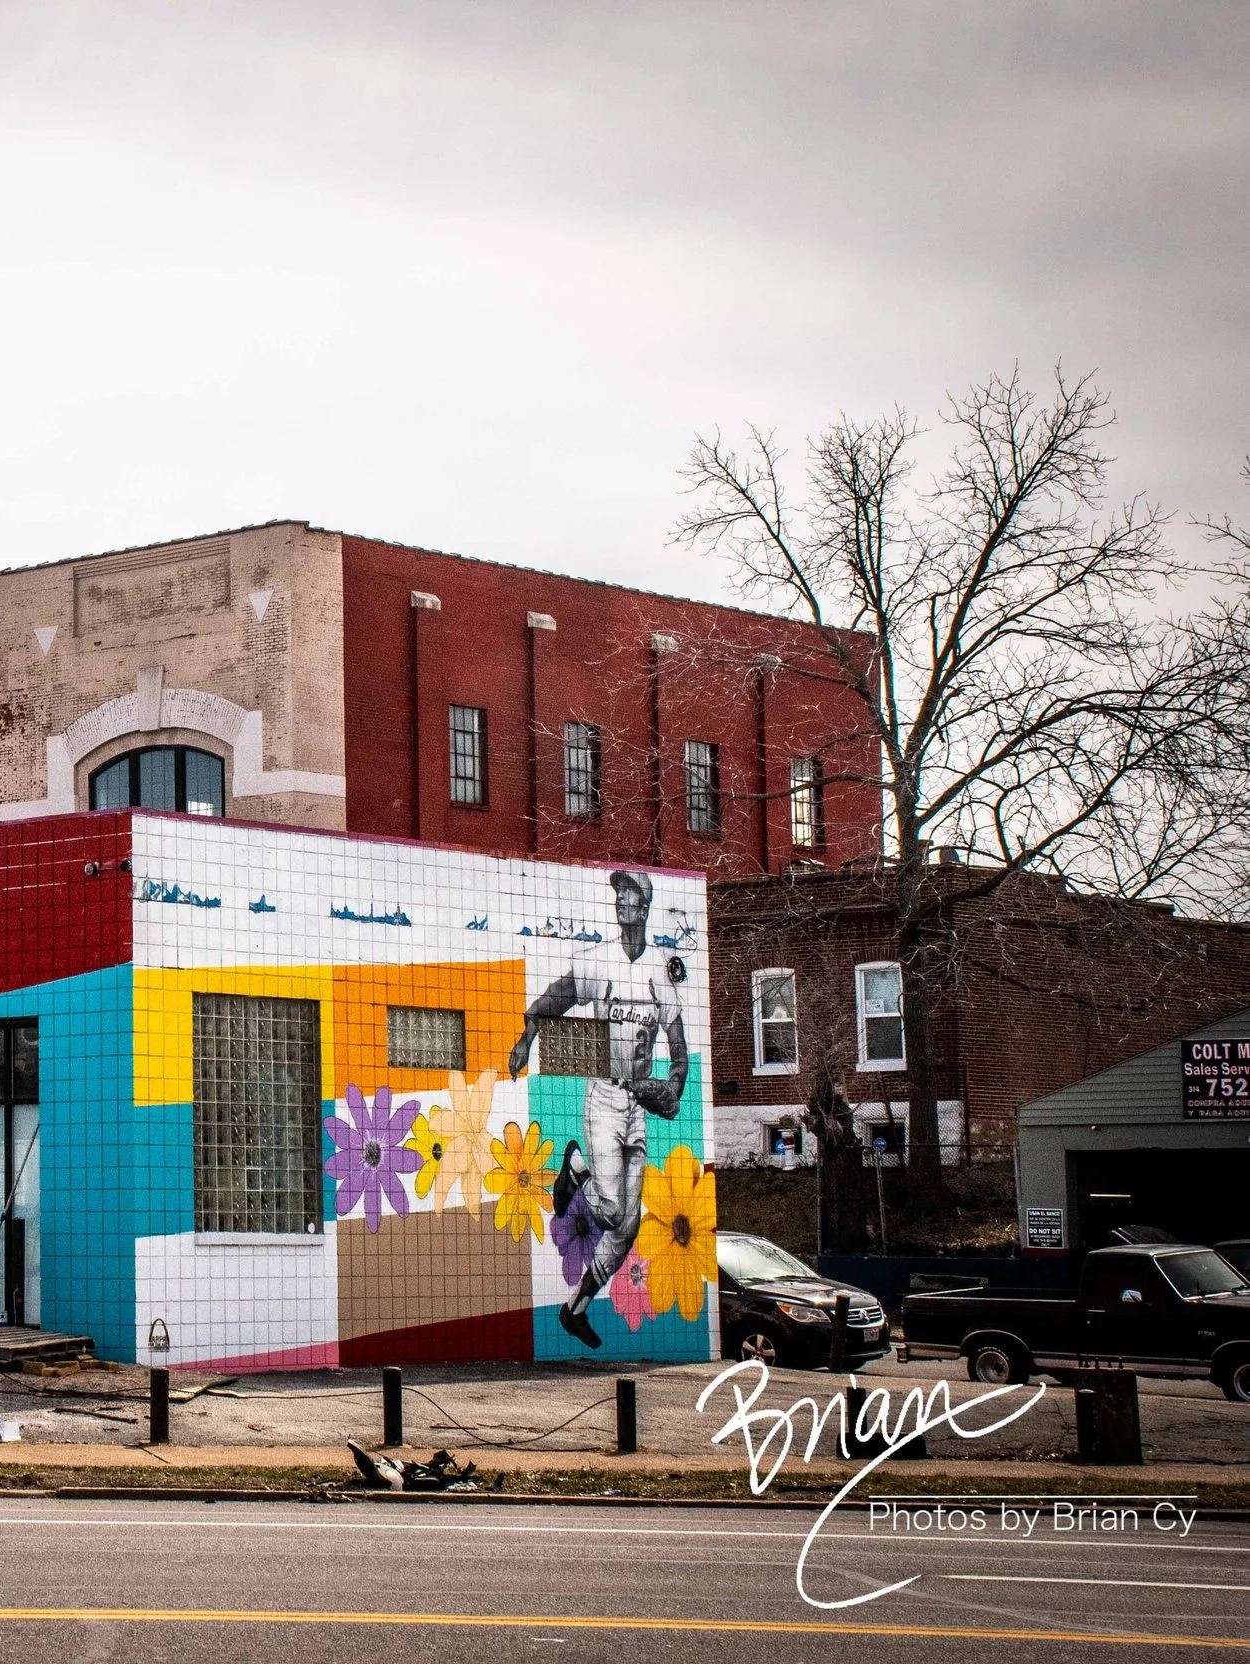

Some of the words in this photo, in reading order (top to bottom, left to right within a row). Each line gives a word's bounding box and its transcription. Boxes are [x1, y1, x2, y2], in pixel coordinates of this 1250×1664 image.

[1192, 1043, 1231, 1060] COLT
[1184, 1062, 1219, 1076] Sales
[1221, 1062, 1250, 1075] Serv
[1188, 1085, 1200, 1093] 314
[1206, 1078, 1249, 1096] 752
